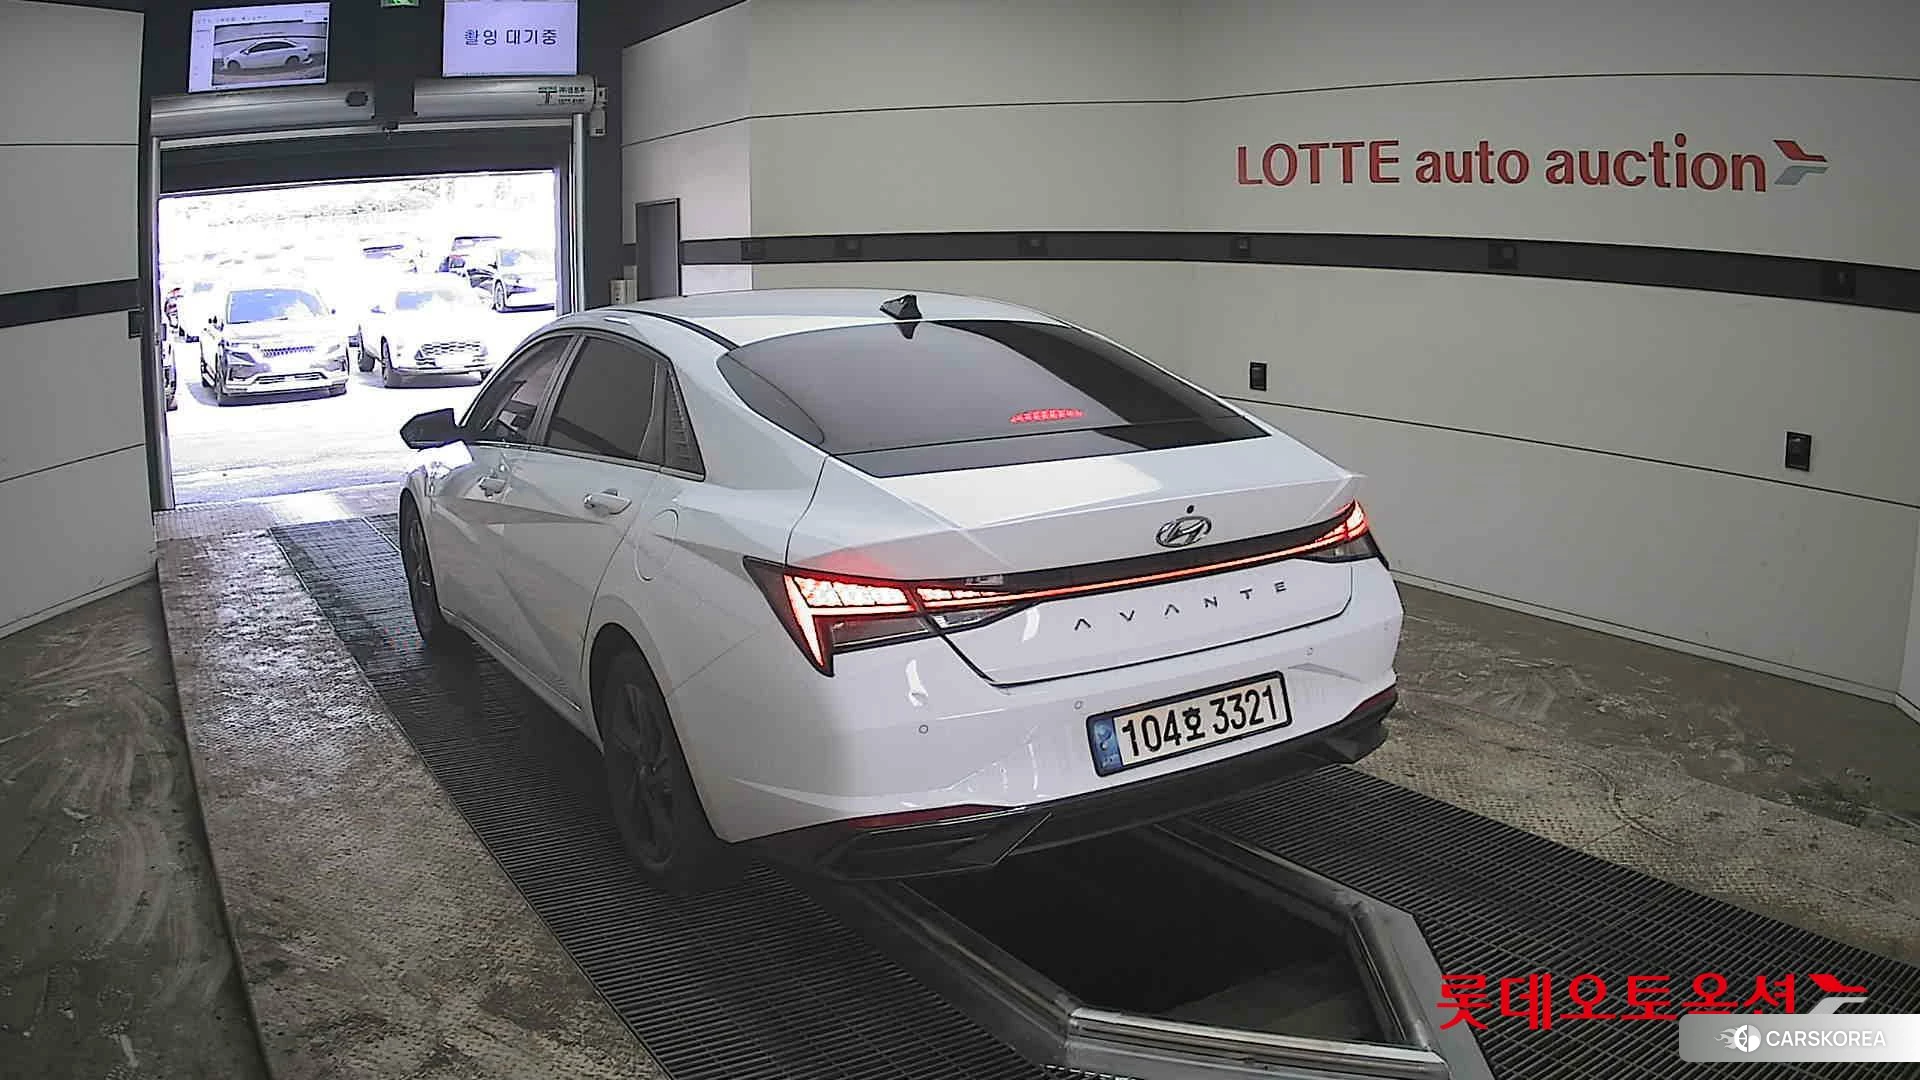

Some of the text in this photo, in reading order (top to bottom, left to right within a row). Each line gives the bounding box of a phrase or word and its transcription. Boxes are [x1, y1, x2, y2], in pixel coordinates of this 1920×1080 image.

[505, 29, 557, 45] 대기중
[1237, 133, 1767, 192] LOTTE auto auction
[1074, 581, 1287, 631] AVANTE
[1209, 684, 1279, 735] 3321
